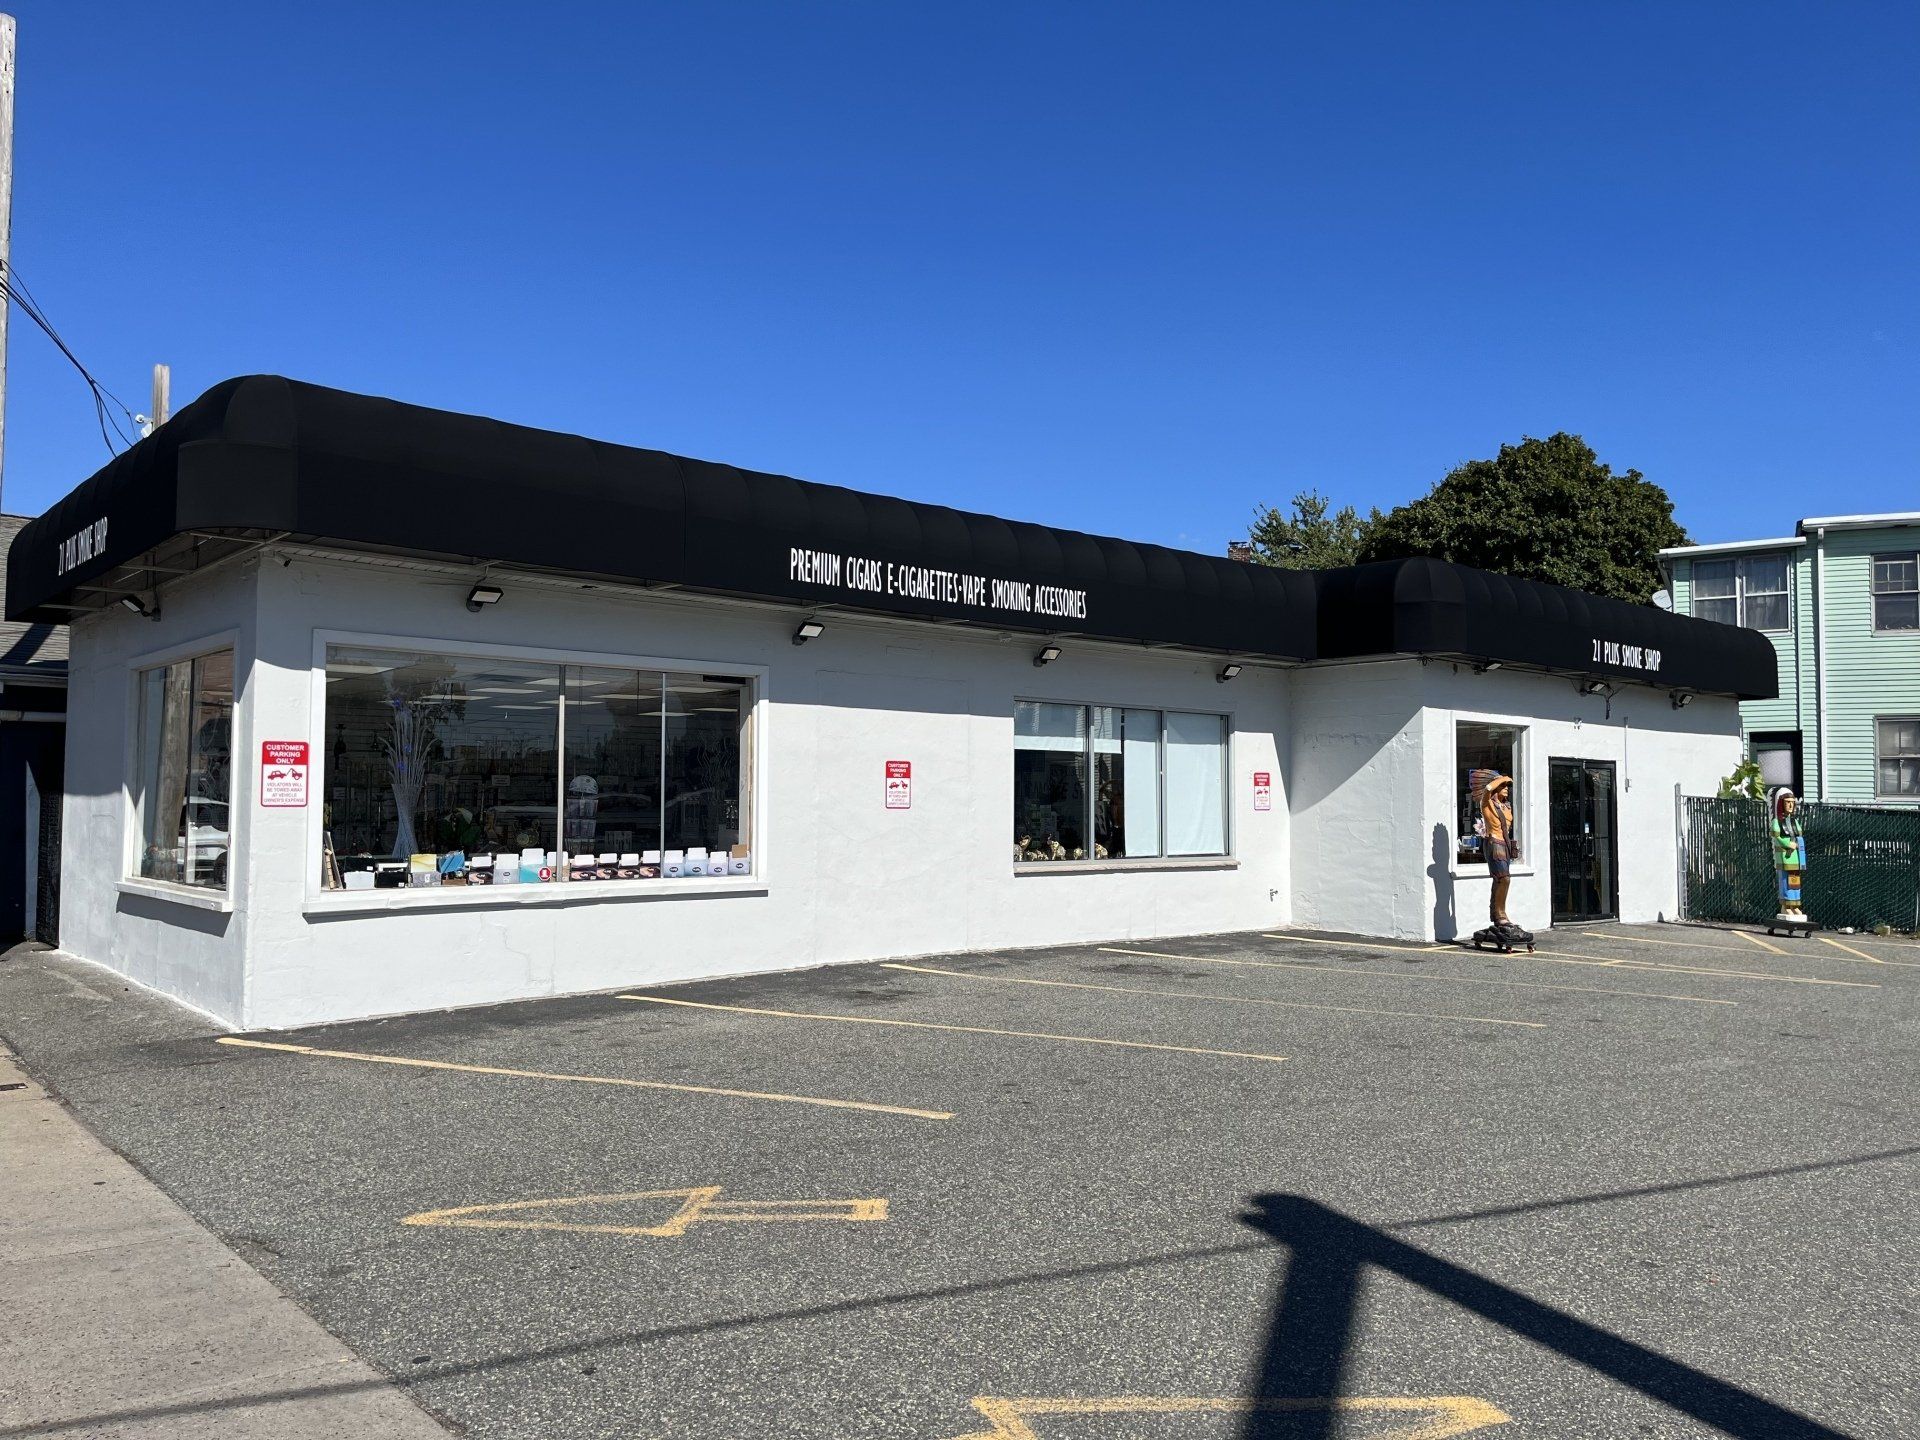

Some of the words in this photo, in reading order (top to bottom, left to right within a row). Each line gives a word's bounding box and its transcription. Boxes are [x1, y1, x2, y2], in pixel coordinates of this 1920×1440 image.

[790, 547, 841, 587] PREMIUM
[846, 556, 882, 593] CIGARS
[991, 578, 1031, 613] SMOKING
[1034, 584, 1087, 619] ACCESSORIES
[1592, 638, 1601, 663] 21
[1604, 641, 1620, 666] PLUS
[1622, 644, 1643, 669] SMOKE
[1644, 648, 1661, 672] SHOP
